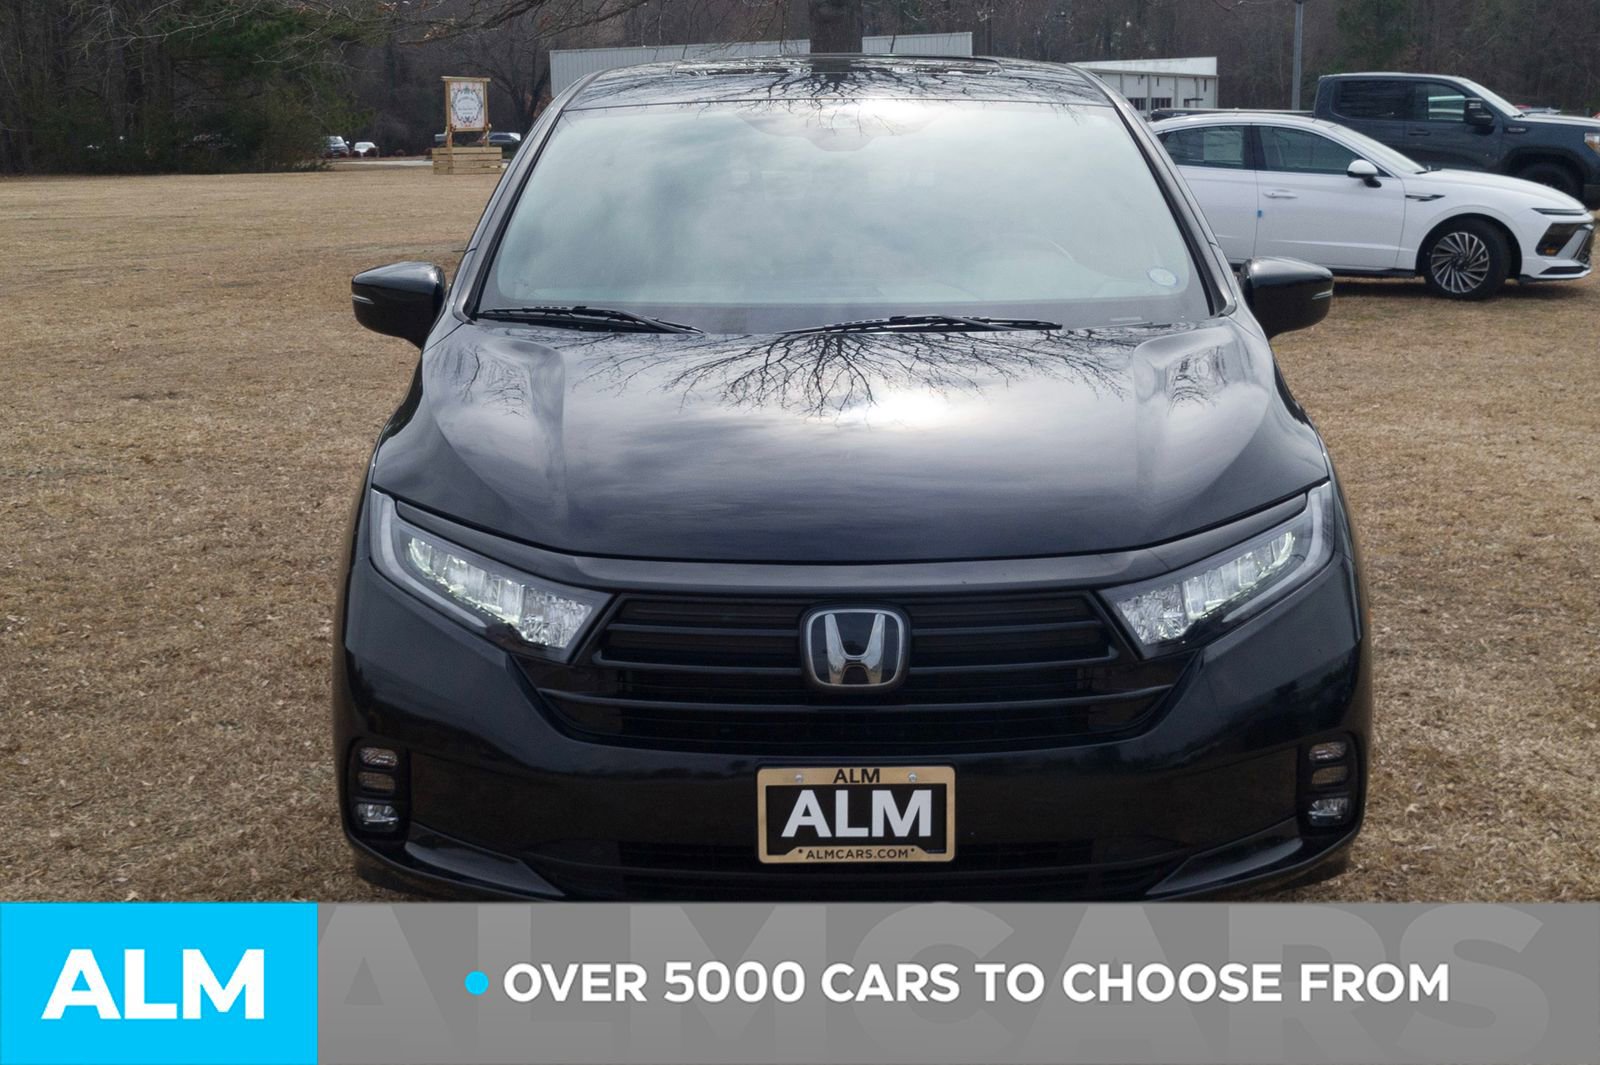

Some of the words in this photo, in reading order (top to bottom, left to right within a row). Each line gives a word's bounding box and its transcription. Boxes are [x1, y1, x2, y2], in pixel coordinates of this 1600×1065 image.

[833, 768, 880, 784] ALM
[781, 789, 932, 838] ALM
[805, 848, 909, 860] ALMCARS.COM
